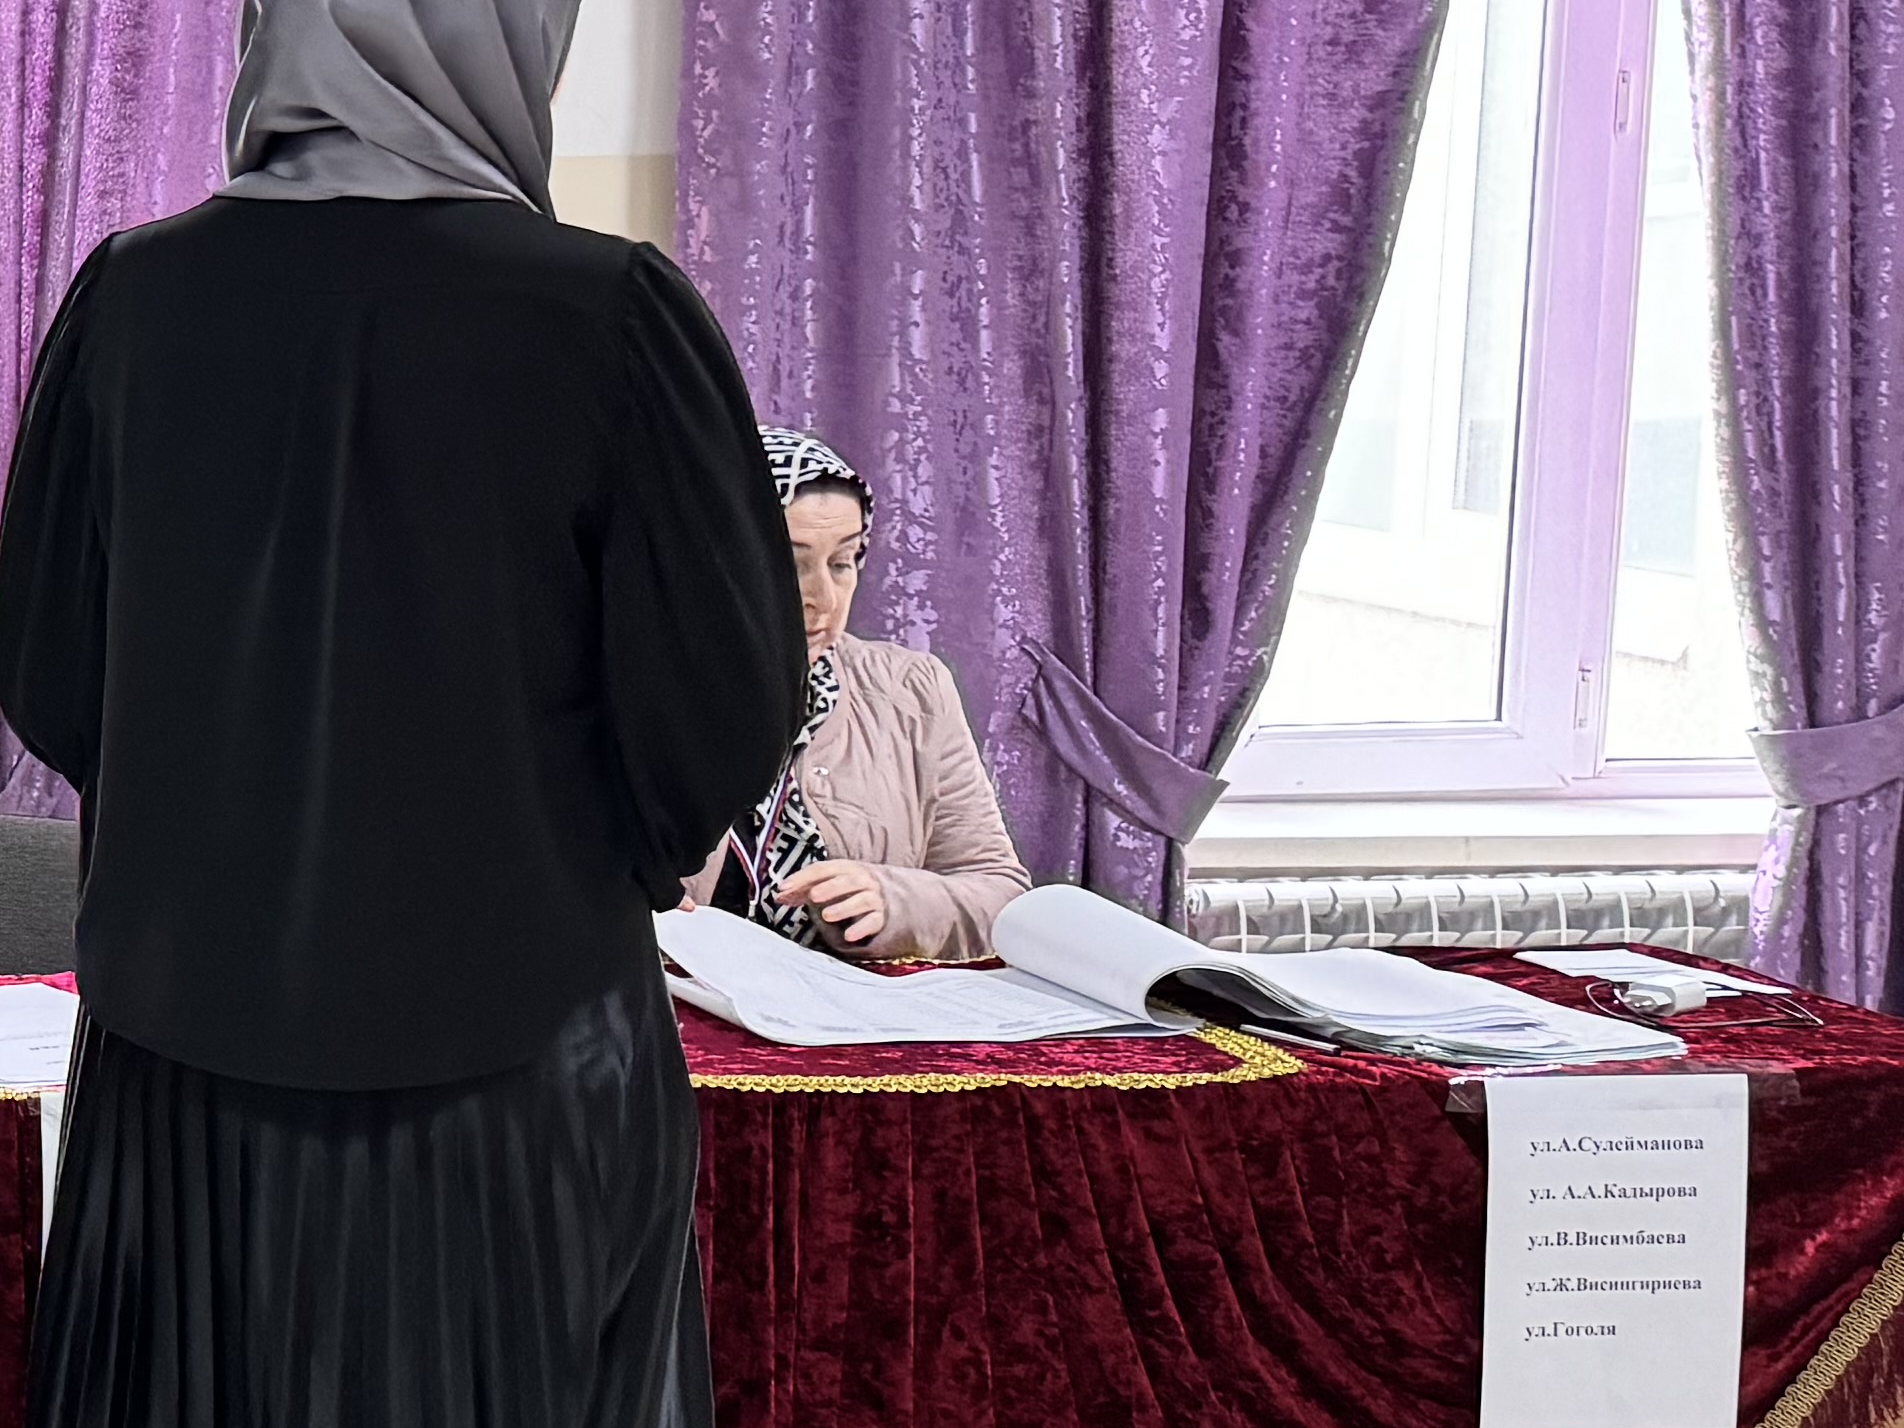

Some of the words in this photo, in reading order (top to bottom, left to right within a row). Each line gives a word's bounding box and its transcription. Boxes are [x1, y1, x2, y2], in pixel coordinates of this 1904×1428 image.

[1529, 1136, 1704, 1157] ул.А.Сулейманова
[1529, 1188, 1556, 1204] ул.
[1562, 1183, 1698, 1202] А.А.Кадырова
[1527, 1230, 1686, 1251] ул.В.Висимбаева
[1524, 1321, 1617, 1342] ул.Гоголя
